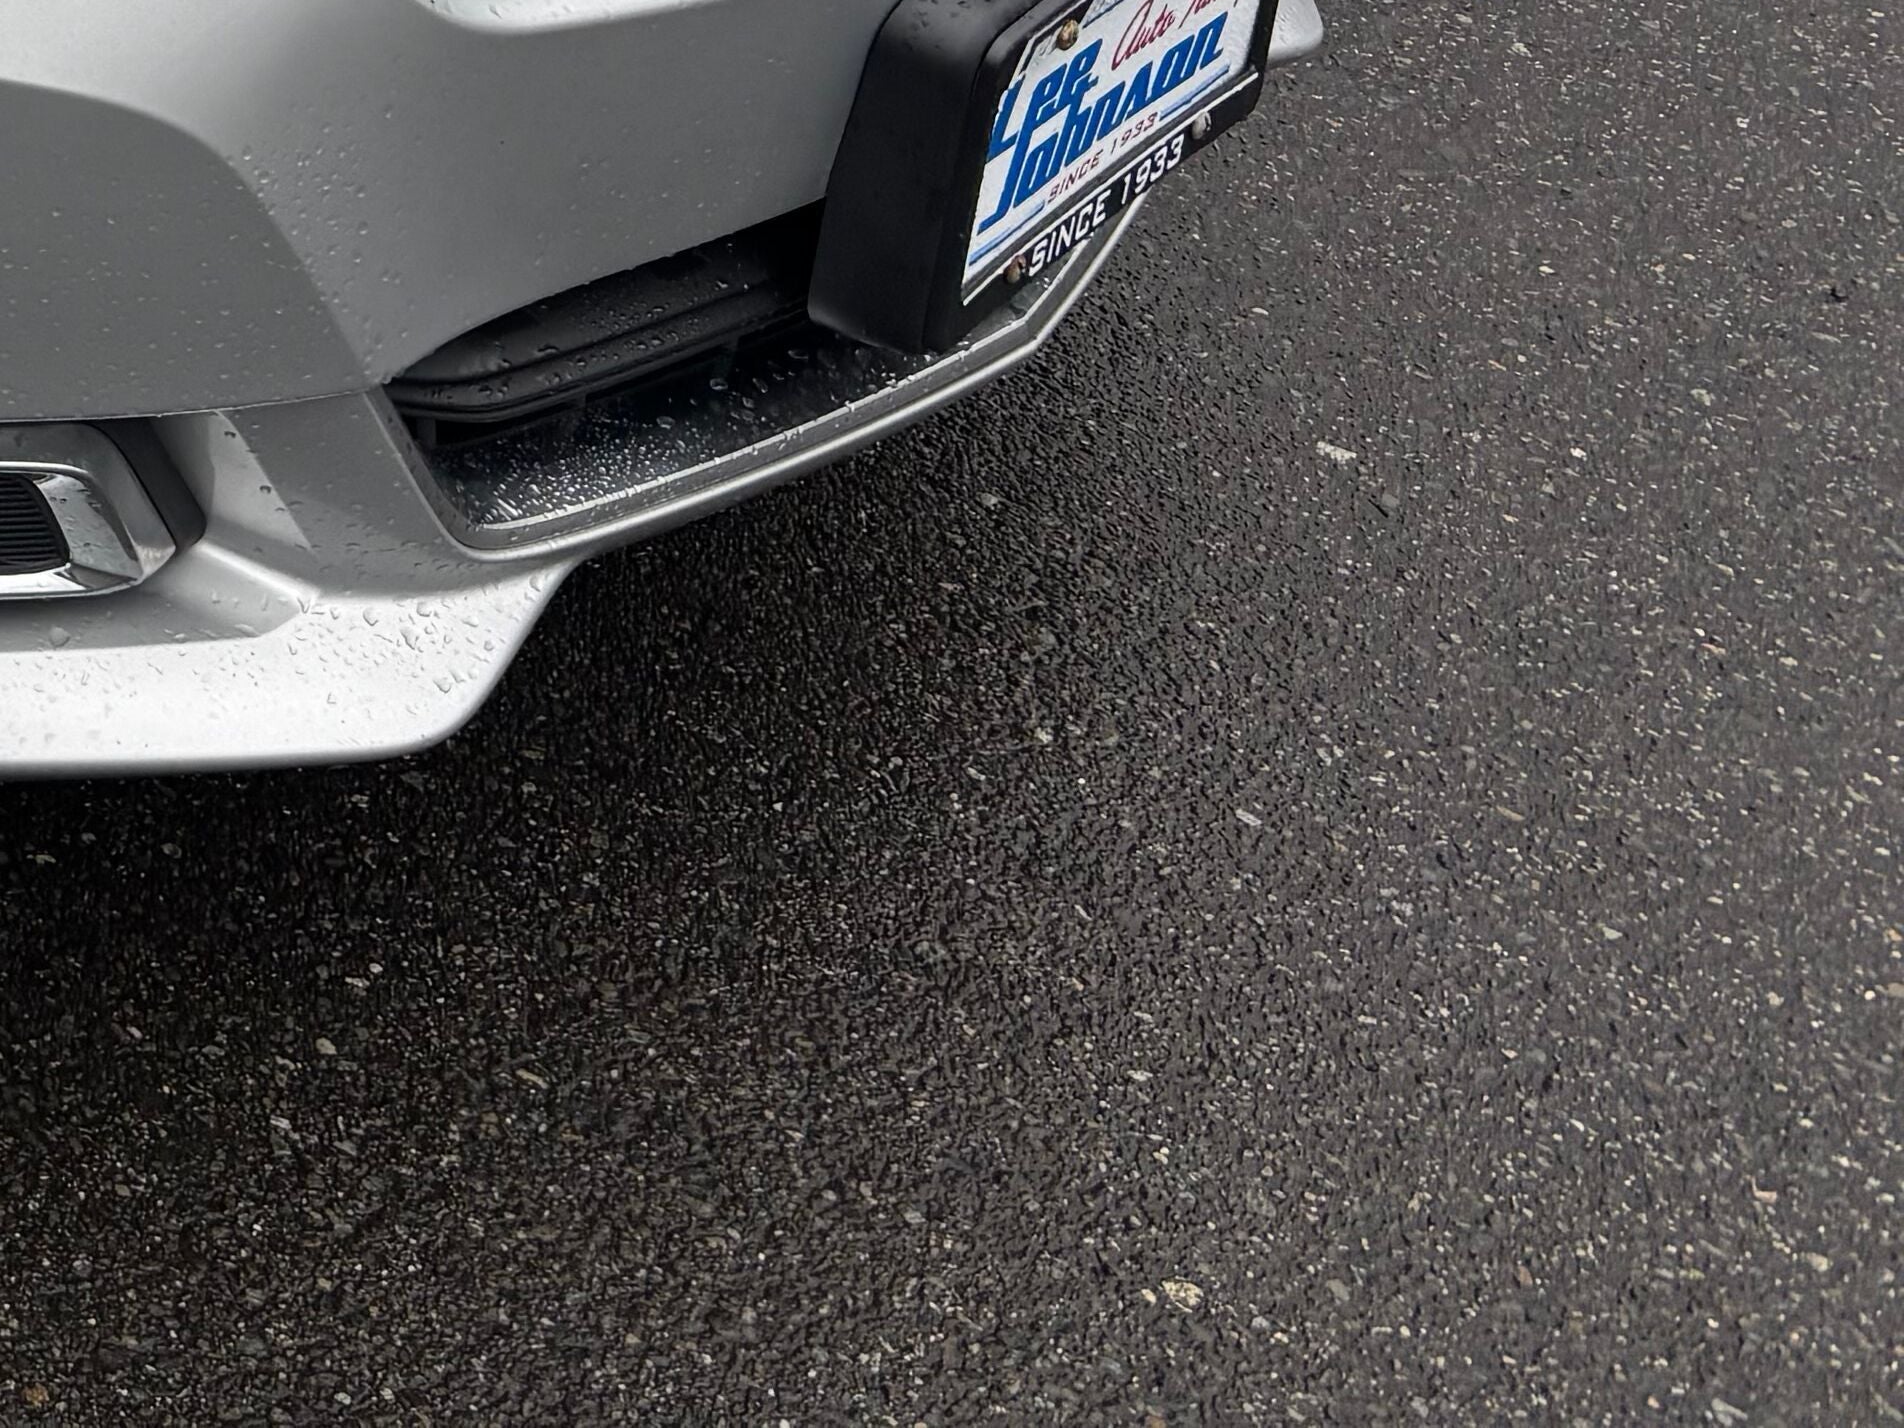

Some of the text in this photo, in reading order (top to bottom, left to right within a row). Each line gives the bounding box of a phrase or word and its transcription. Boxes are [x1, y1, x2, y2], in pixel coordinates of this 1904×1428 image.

[977, 11, 1229, 236] Johnson
[986, 38, 1103, 164] Lee
[1047, 111, 1158, 205] SINCE 1933
[1028, 132, 1185, 277] SINCE 1933
